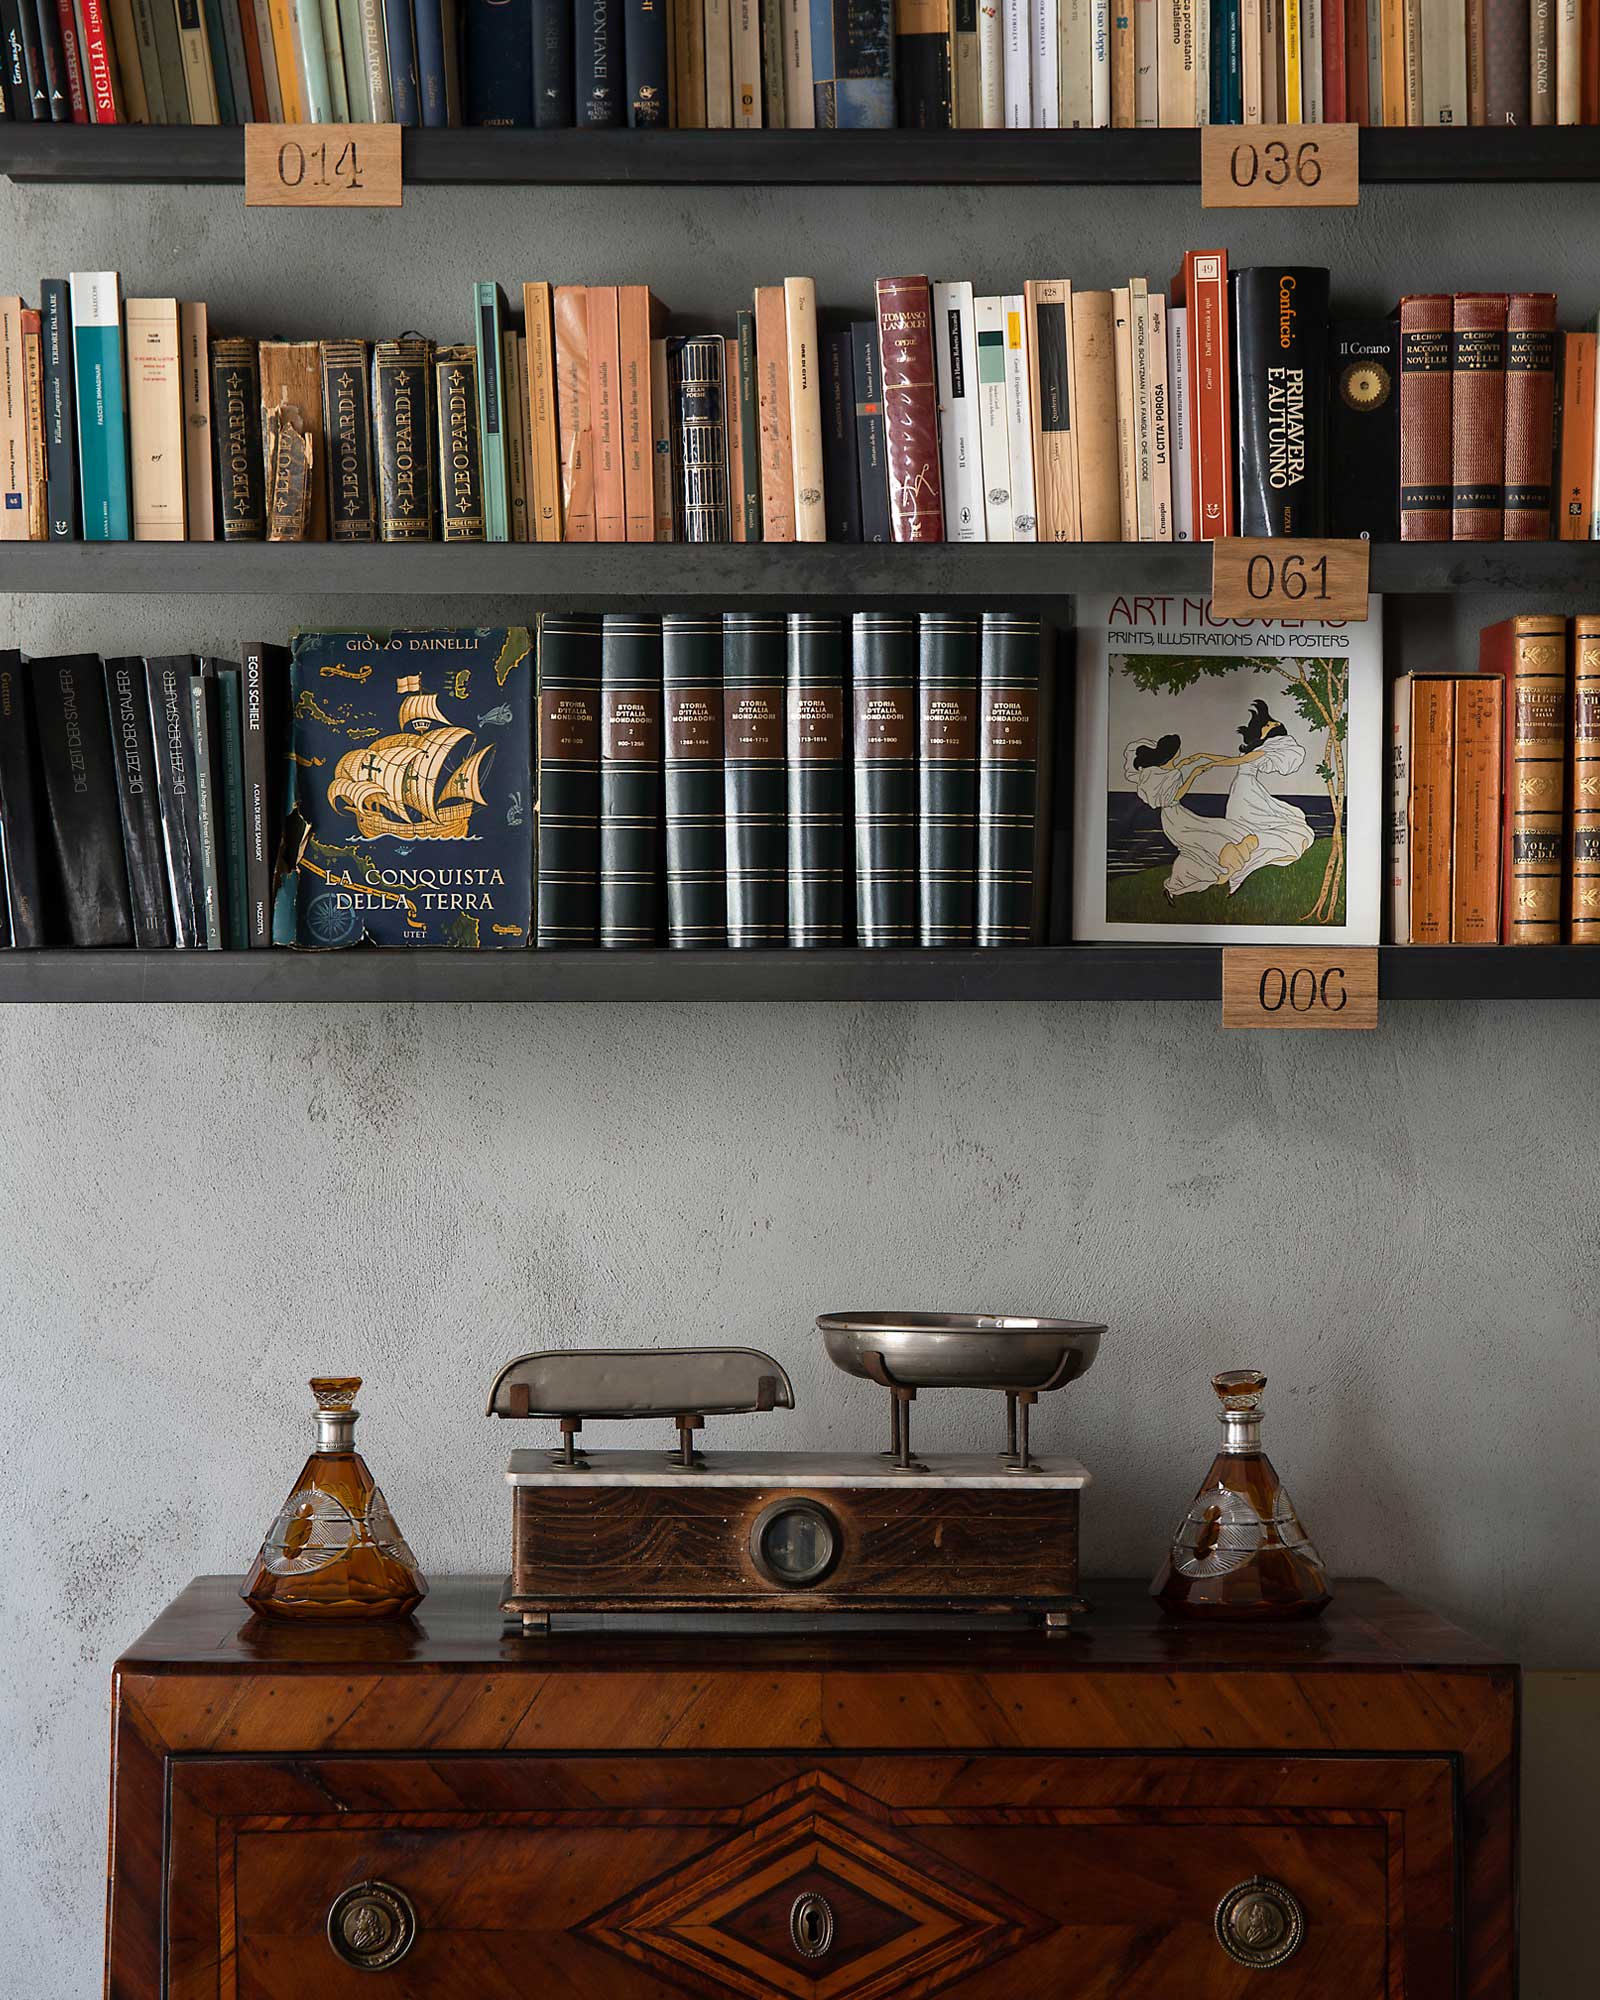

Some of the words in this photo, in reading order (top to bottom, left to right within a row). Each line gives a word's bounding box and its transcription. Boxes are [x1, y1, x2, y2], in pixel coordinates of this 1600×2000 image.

[1097, 11, 1105, 28] suo
[366, 18, 380, 54] DELLA
[1012, 43, 1018, 52] LA
[1094, 30, 1107, 62] doppio
[1183, 12, 1192, 71] protestante
[1040, 46, 1046, 56] LA
[63, 29, 83, 110] PALERMO
[91, 41, 111, 109] SICILIA
[370, 54, 383, 94] TORRE
[1537, 47, 1549, 94] TECNICA
[1506, 112, 1517, 126] R
[278, 142, 364, 189] 014
[1231, 141, 1323, 187] 036
[1202, 264, 1214, 273] 49
[50, 293, 58, 314] MARE
[1042, 287, 1057, 297] 428
[882, 311, 926, 322] TOMMASO
[1153, 312, 1161, 334] Soglie
[1279, 275, 1297, 349] Confucio
[883, 320, 927, 331] LANDOLFI
[51, 331, 60, 365] TERRORE
[894, 338, 917, 346] OPERE
[1340, 343, 1349, 355] Il
[1350, 342, 1391, 355] Corano
[1406, 345, 1448, 353] RACCONTI
[1458, 344, 1500, 352] RACCONTI
[1511, 344, 1551, 352] RACCONTI
[801, 359, 806, 368] DI
[1138, 347, 1146, 390] SCHATZMAN
[1406, 356, 1448, 364] NOVELLE
[1457, 355, 1499, 363] NOVELLE
[1511, 355, 1550, 363] NOVELLE
[95, 363, 103, 399] IMMAGINARI
[1267, 367, 1286, 381] E
[53, 377, 62, 417] Langewiesche
[1050, 391, 1058, 423] Quaderni
[1140, 395, 1147, 405] LA
[1155, 384, 1164, 421] POROSA
[54, 419, 62, 444] William
[1140, 407, 1148, 438] FAMIGLIA
[1287, 368, 1305, 486] PRIMAVERA
[227, 389, 250, 499] LEOPARDI
[338, 389, 360, 499] LEOPARDI
[394, 387, 415, 497] LEOPARDI
[449, 386, 472, 497] LEOPARDI
[1156, 423, 1165, 451] CITTA'
[1268, 384, 1287, 489] AUTUNNO
[1157, 452, 1165, 464] LA
[1159, 502, 1167, 535] Cronopio
[1247, 555, 1332, 600] 061
[1108, 596, 1175, 626] ART
[409, 638, 479, 650] DAINELLI
[1107, 631, 1154, 645] PRINTS,
[1157, 631, 1252, 646] ILLUSTRATIONS
[1256, 634, 1285, 647] AND
[1289, 634, 1350, 648] POSTERS
[248, 656, 258, 687] EGON
[1, 672, 12, 716] Guttuso
[59, 668, 79, 724] STAUFER
[116, 670, 135, 722] STAUFER
[163, 670, 179, 723] STAUFER
[250, 686, 260, 730] SCHIELE
[1429, 709, 1437, 733] Popper
[67, 725, 81, 748] DER
[124, 722, 138, 748] DER
[167, 723, 181, 748] DER
[71, 749, 84, 773] ZEIT
[127, 749, 140, 774] ZEIT
[170, 749, 184, 774] ZEIT
[75, 776, 88, 793] DIE
[130, 777, 143, 795] DIE
[173, 777, 187, 795] DIE
[254, 814, 262, 832] SERGE
[255, 832, 263, 862] SABARSKY
[325, 869, 353, 886] LA
[365, 869, 505, 890] CONQUISTA
[336, 893, 409, 911] DELLA
[421, 893, 494, 911] TERRA
[210, 928, 216, 937] 2
[403, 931, 427, 939] UTET
